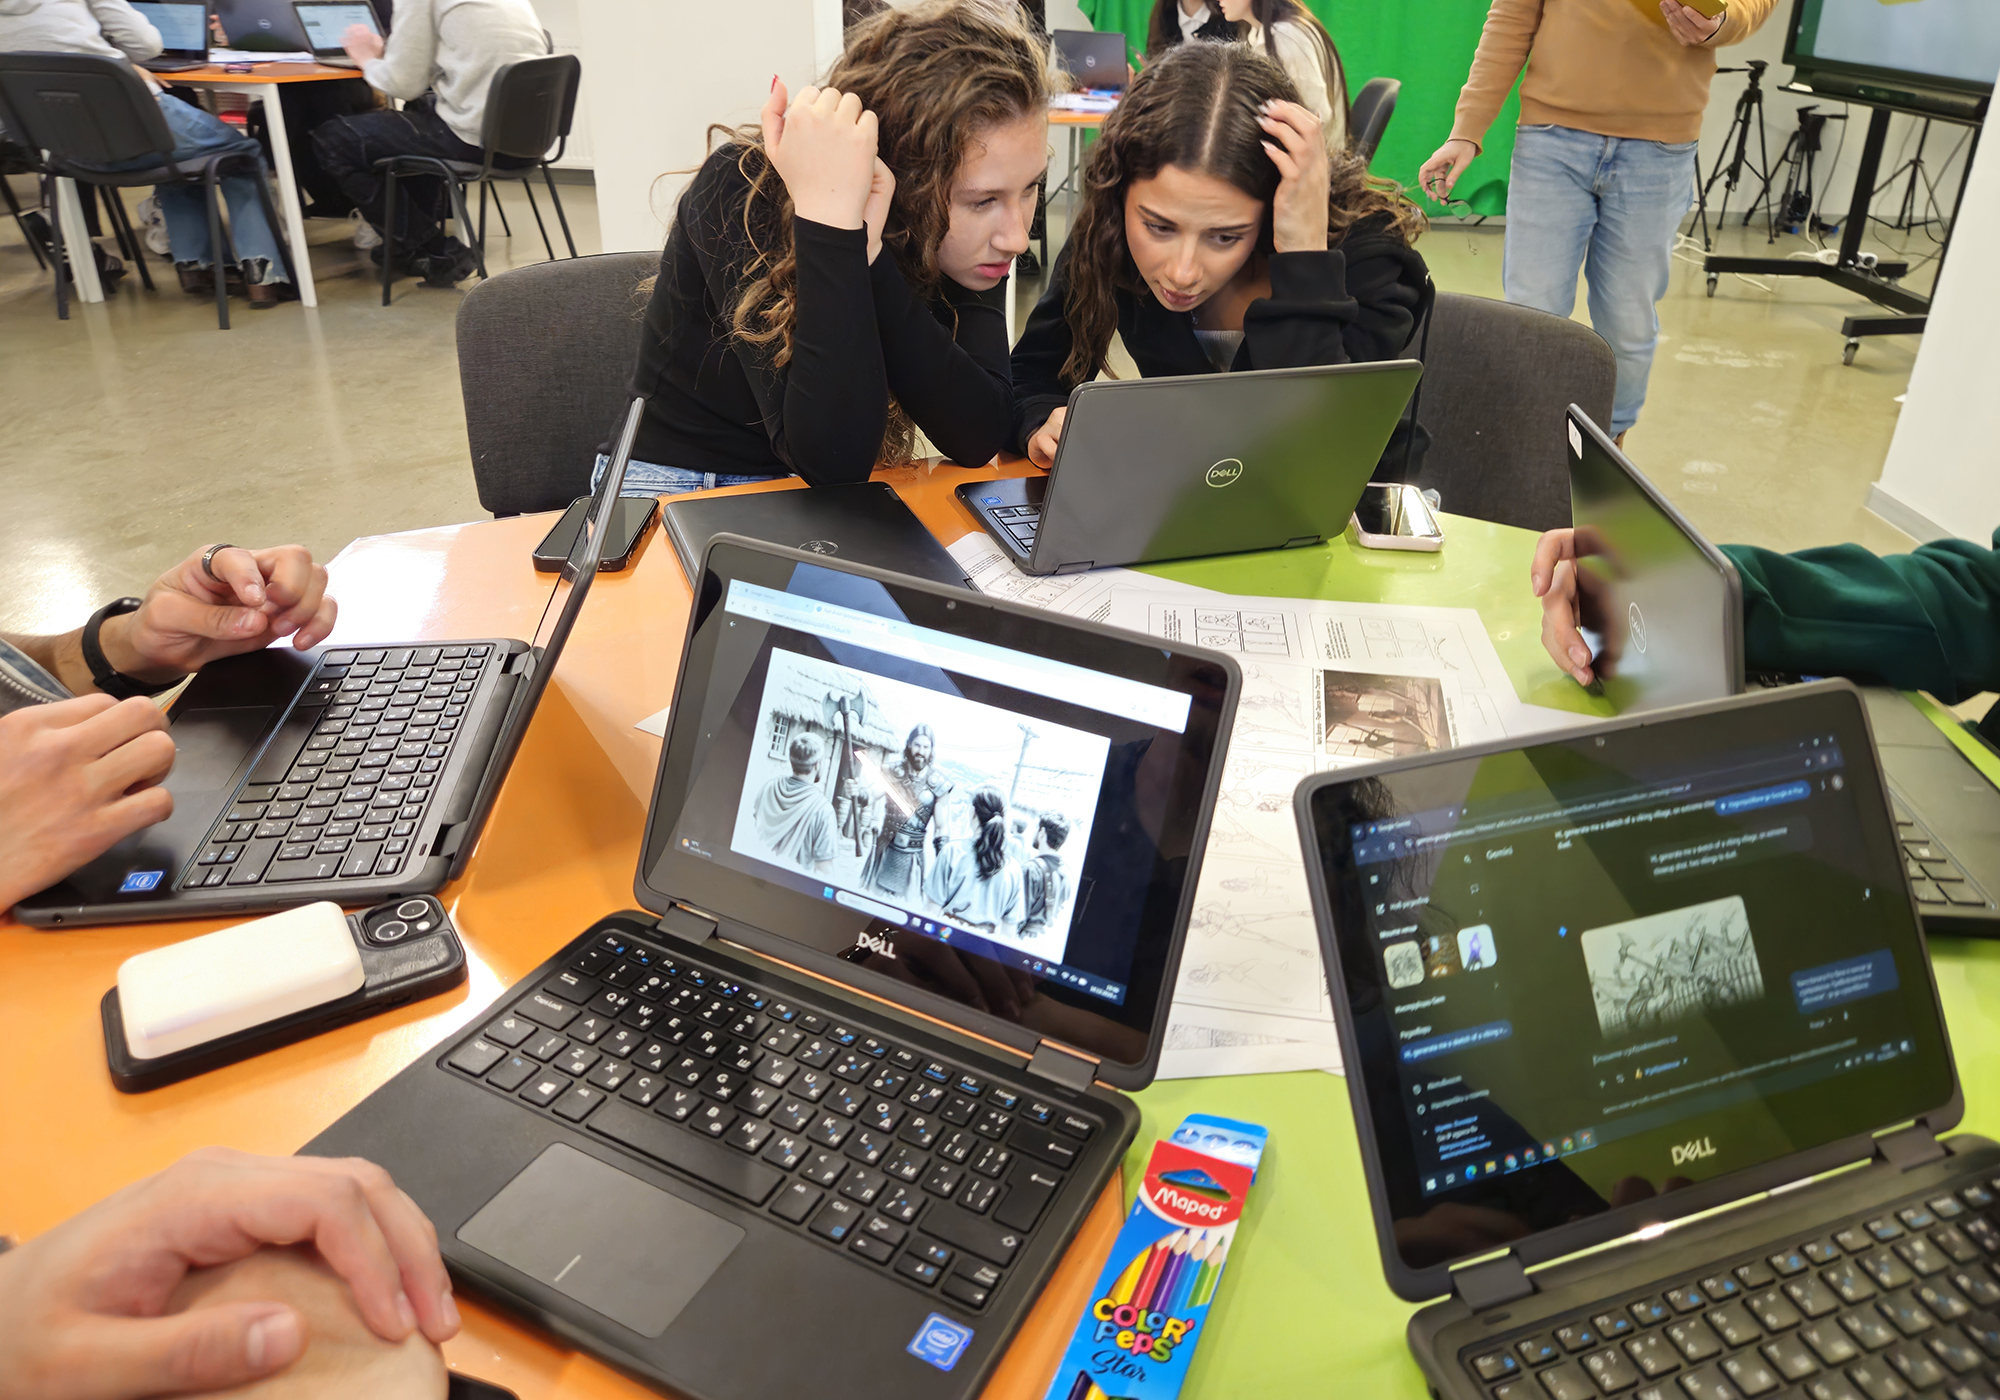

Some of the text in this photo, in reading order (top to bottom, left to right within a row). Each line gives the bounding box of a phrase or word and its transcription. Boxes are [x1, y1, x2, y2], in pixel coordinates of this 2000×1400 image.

[1210, 468, 1237, 478] DELL
[857, 931, 897, 960] DELL
[1065, 1117, 1089, 1130] Delete
[1671, 1136, 1717, 1166] DELL
[1153, 1187, 1223, 1221] Maped
[1091, 1349, 1147, 1383] Star
